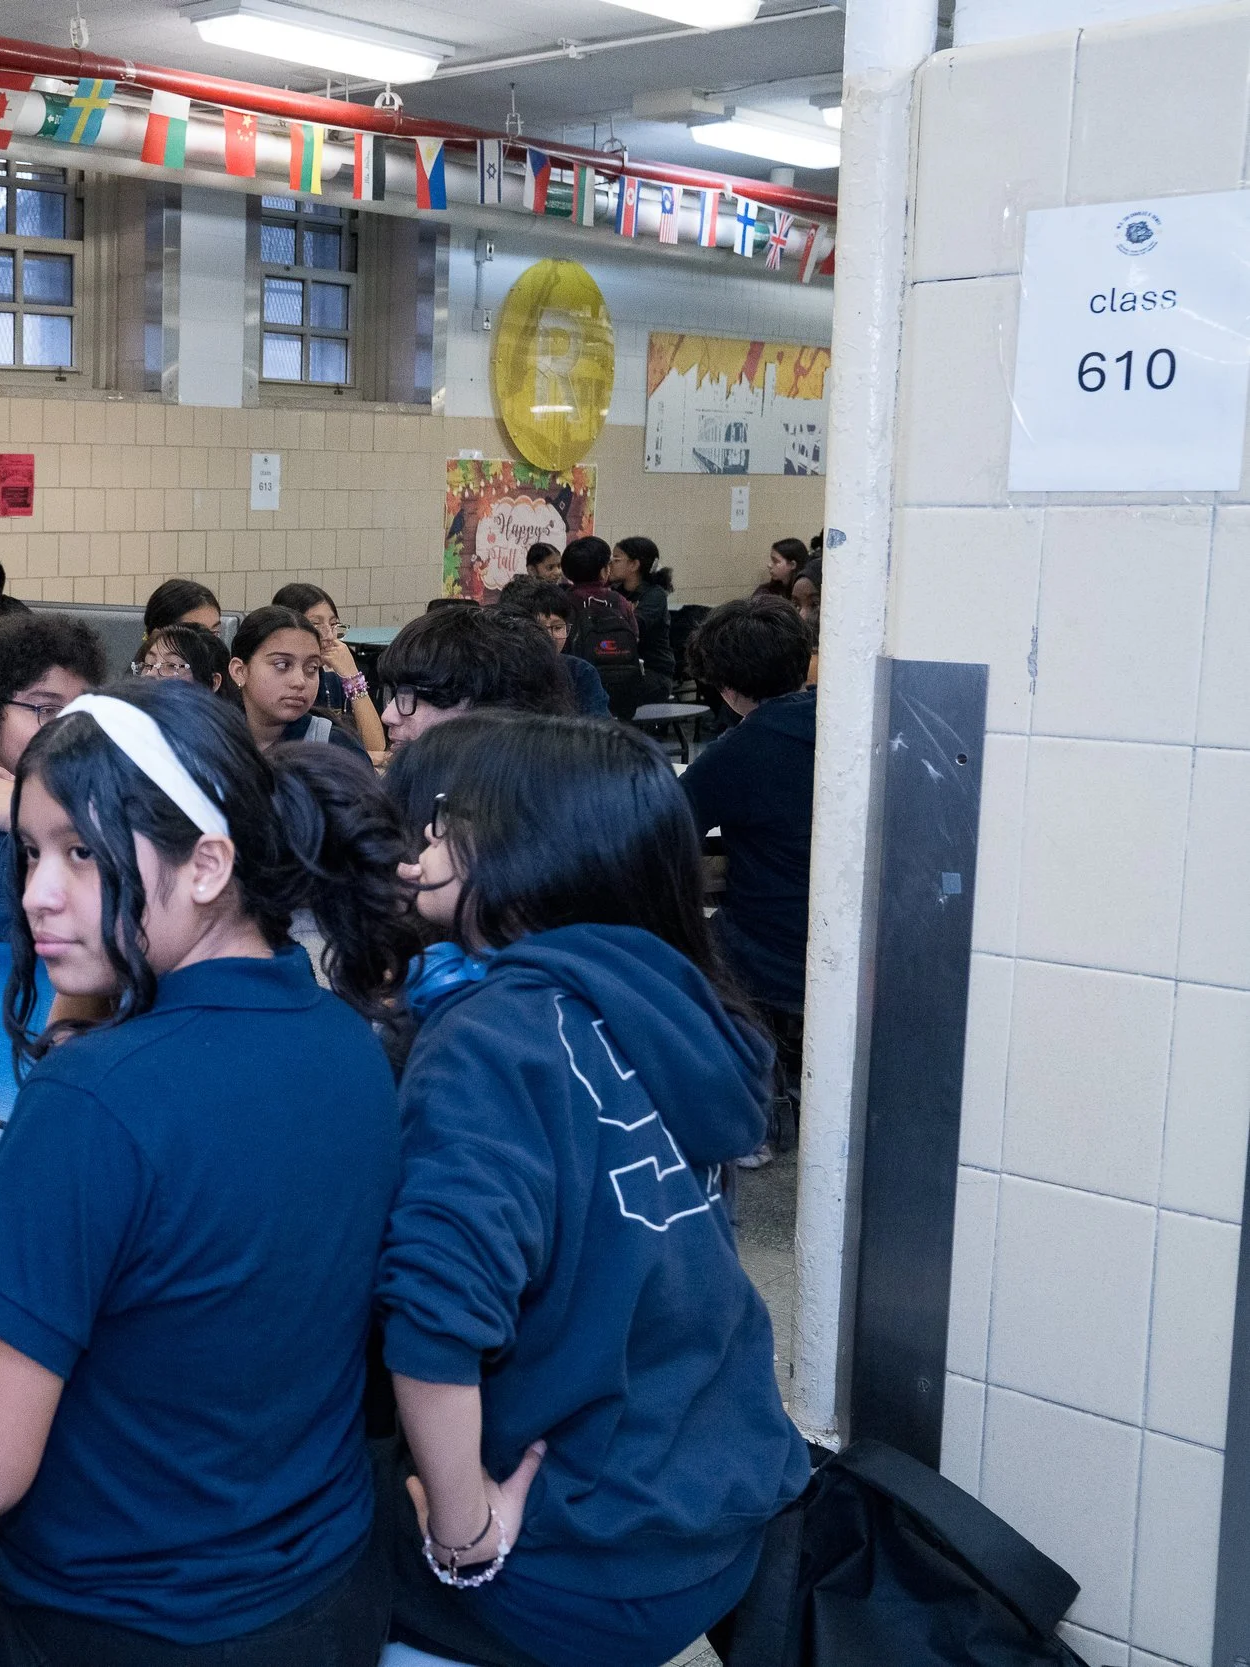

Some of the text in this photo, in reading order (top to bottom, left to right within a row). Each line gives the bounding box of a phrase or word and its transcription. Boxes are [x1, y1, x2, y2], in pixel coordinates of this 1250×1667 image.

[1090, 287, 1176, 314] class
[1078, 348, 1176, 392] 610
[258, 482, 272, 491] 613
[494, 512, 554, 544] Happy
[488, 544, 517, 571] Fall
